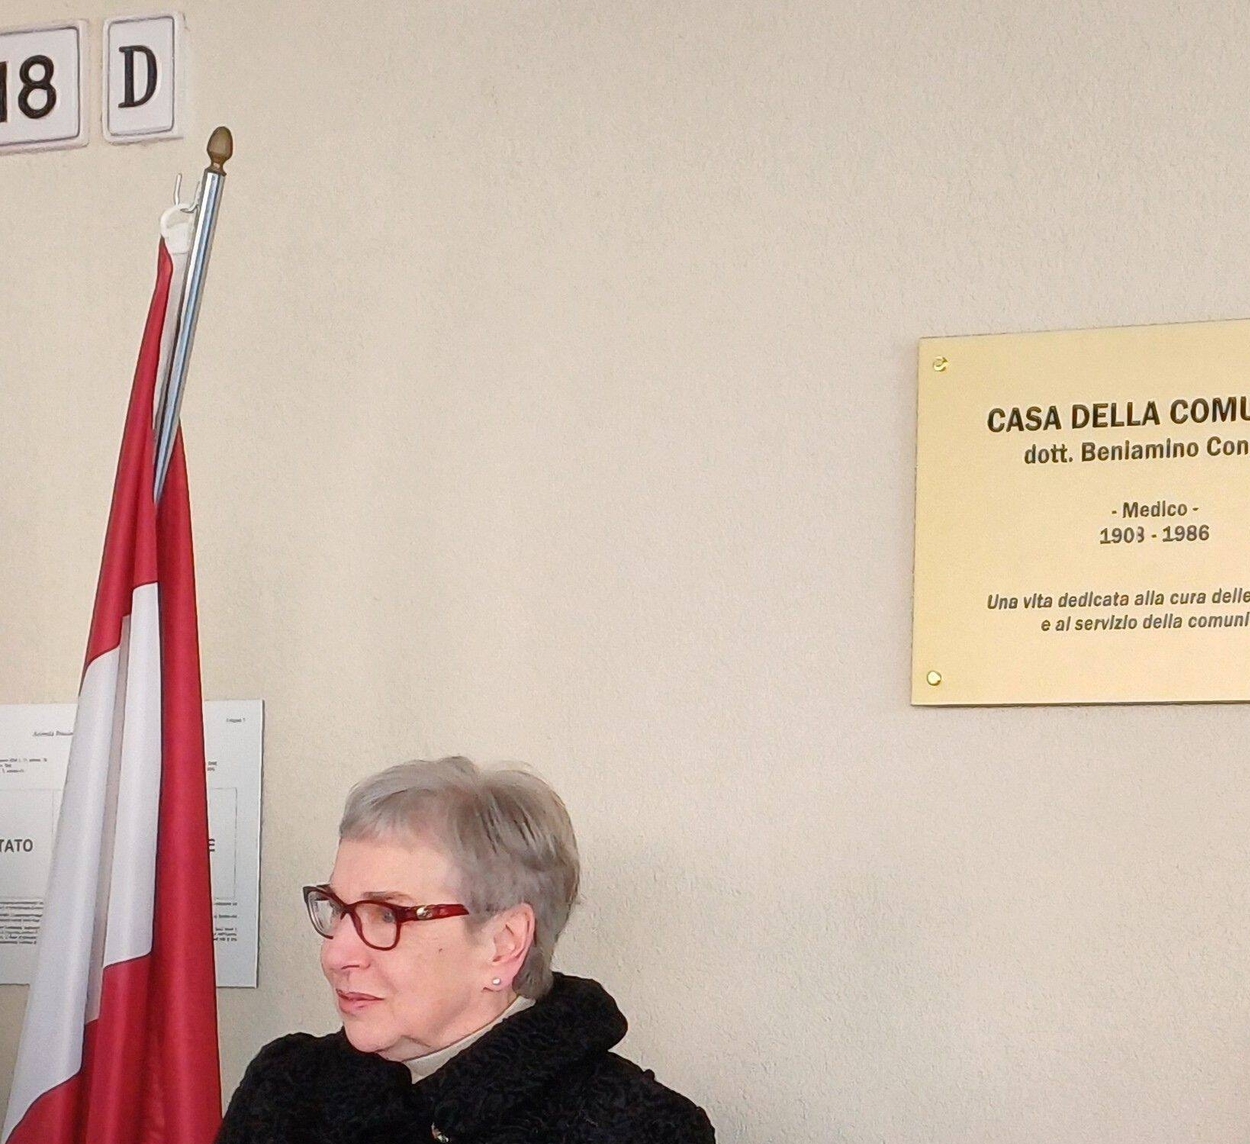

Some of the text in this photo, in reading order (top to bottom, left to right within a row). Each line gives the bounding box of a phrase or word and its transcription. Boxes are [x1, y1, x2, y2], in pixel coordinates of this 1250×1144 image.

[118, 44, 158, 109] D
[986, 405, 1063, 434] CASA
[1071, 400, 1161, 430] DELLA
[1023, 443, 1074, 465] dott.
[1081, 437, 1200, 463] Beniamino
[1121, 499, 1188, 519] Medico
[1161, 524, 1210, 543] 1986
[986, 593, 1019, 611] Una
[1023, 592, 1053, 610] vita
[1057, 590, 1130, 608] dedicata
[1133, 589, 1165, 606] alla
[1169, 592, 1207, 605] cura
[1040, 619, 1052, 632] e
[1054, 615, 1072, 632] al
[1074, 613, 1138, 632] servizio
[1142, 612, 1183, 630] della
